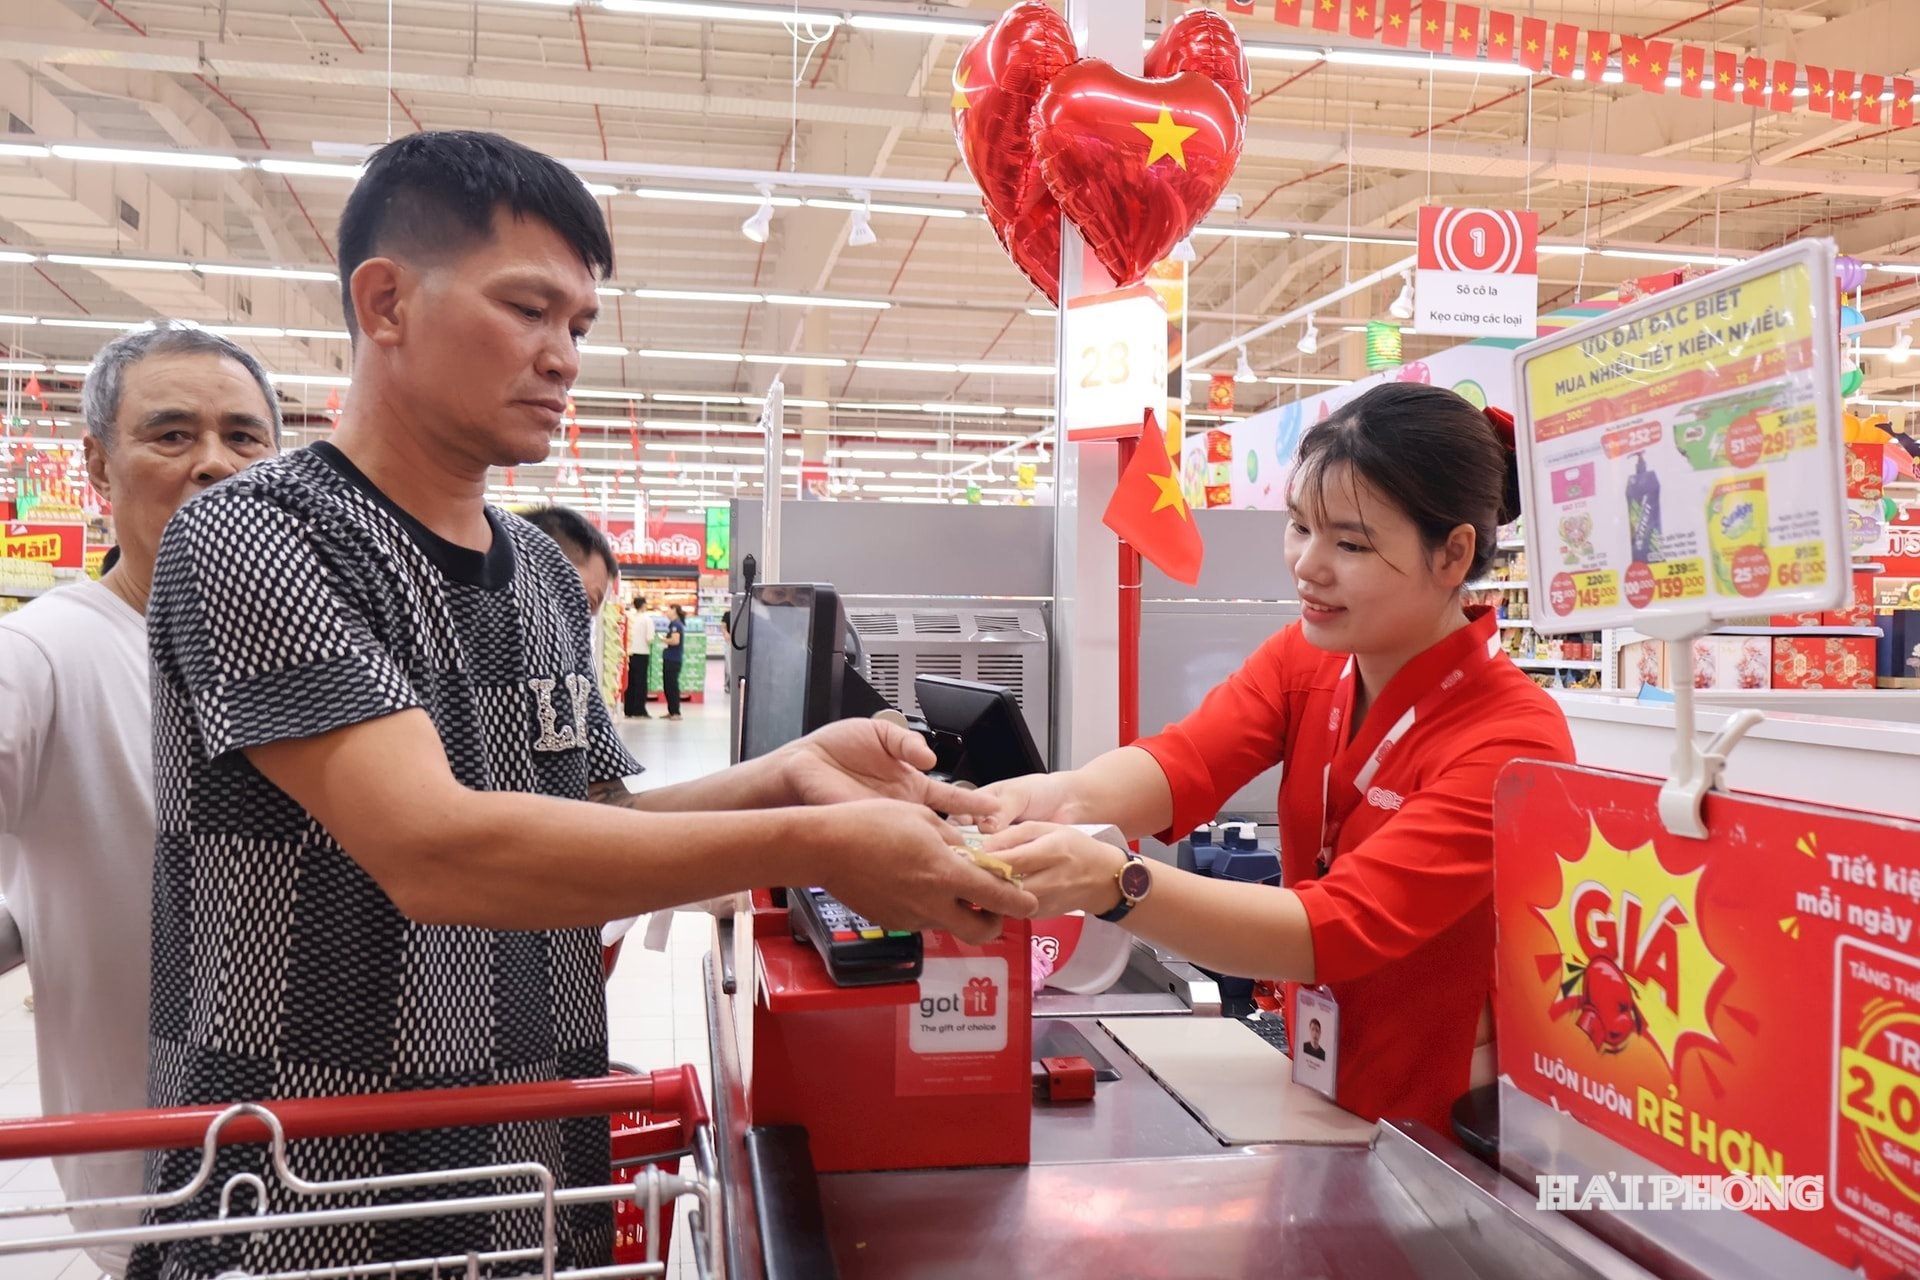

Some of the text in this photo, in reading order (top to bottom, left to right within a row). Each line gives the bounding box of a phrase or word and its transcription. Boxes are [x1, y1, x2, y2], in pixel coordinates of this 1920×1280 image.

[1470, 228, 1486, 258] 1
[1456, 284, 1498, 296] Sô cô la
[1430, 311, 1522, 327] Kẹo cứng các loại
[1555, 376, 1586, 396] MUA
[1826, 853, 1877, 888] Tiết
[1796, 885, 1912, 943] mỗi ngày
[1571, 880, 1690, 1016] GIÁ
[920, 991, 987, 1018] got it
[921, 1023, 997, 1034] The gift of choice
[1534, 1052, 1783, 1193] LUÔN LUÔN RẺ HƠN
